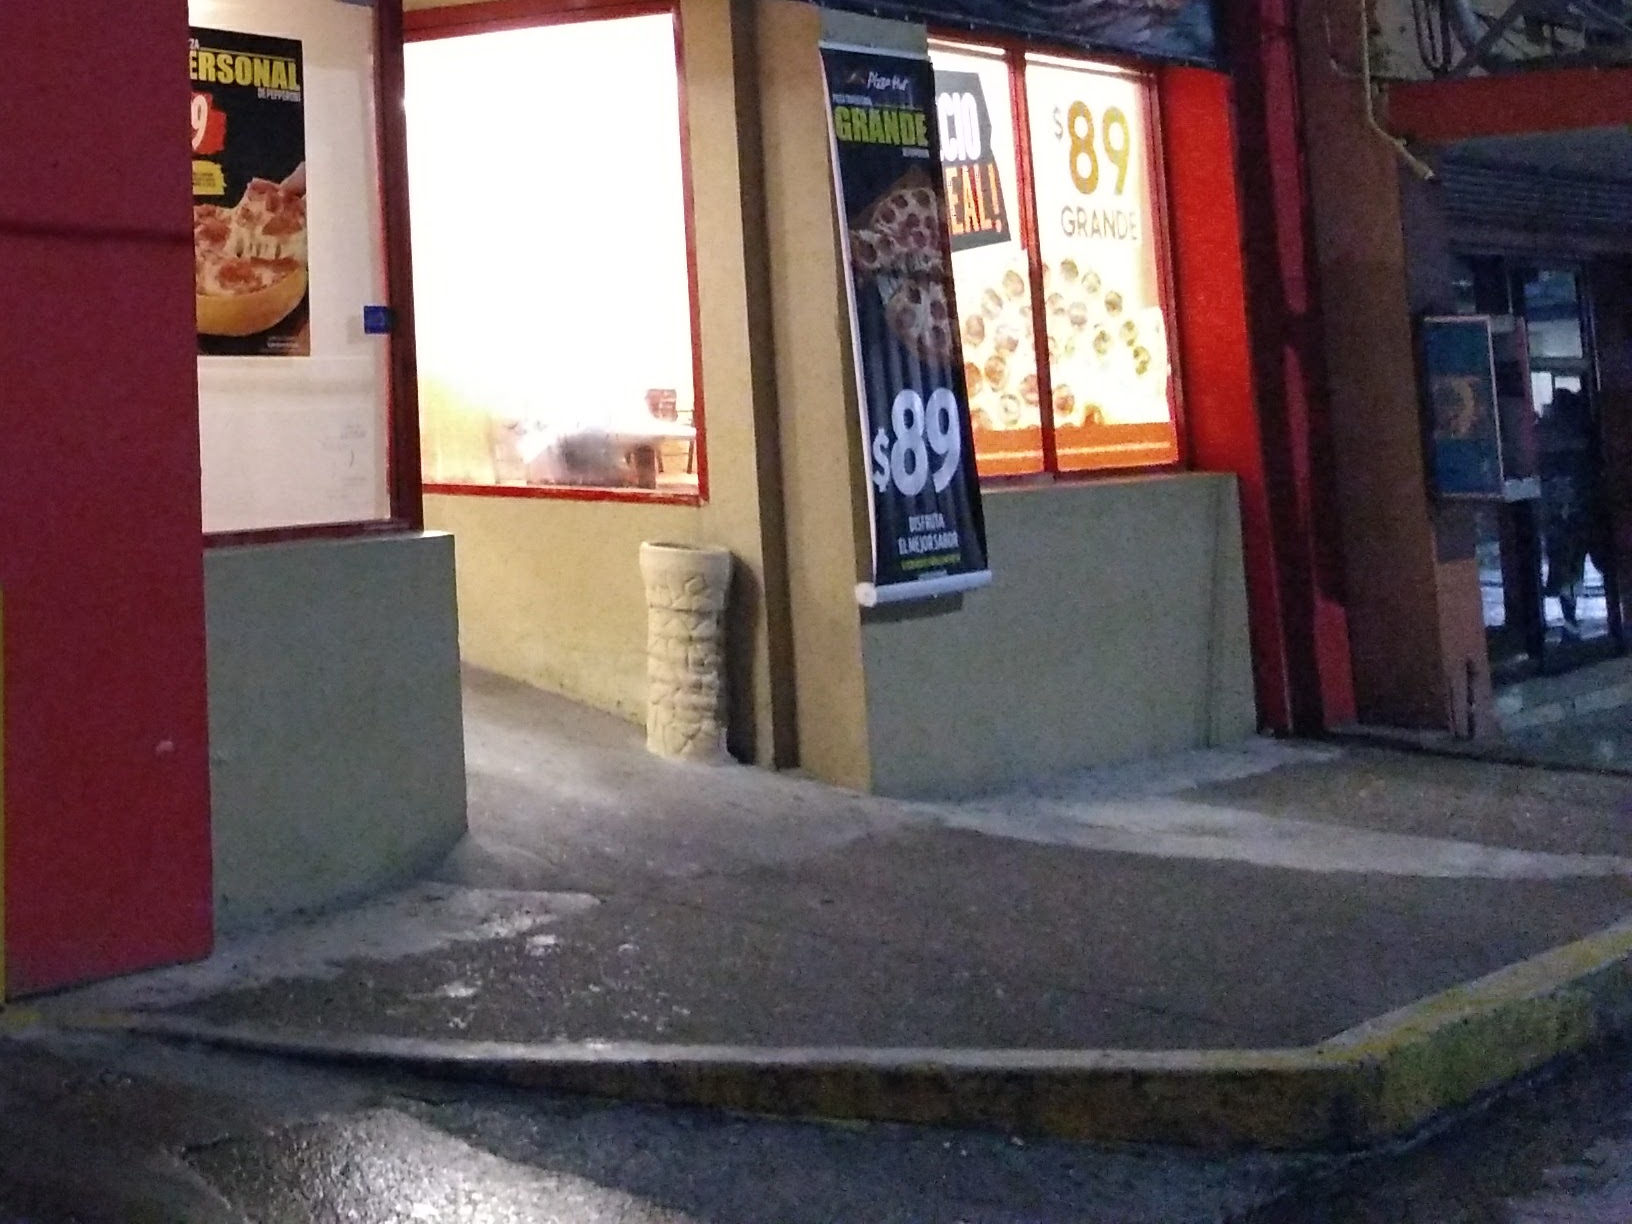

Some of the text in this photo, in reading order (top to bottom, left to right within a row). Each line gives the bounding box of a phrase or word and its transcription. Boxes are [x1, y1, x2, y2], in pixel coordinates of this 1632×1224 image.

[189, 50, 301, 92] ERSONAL
[834, 105, 929, 147] GRANDE
[936, 92, 981, 162] CIO
[1053, 100, 1131, 196] $89
[945, 163, 1002, 235] EAL!
[1061, 205, 1138, 241] GRANDE
[872, 387, 962, 497] $89
